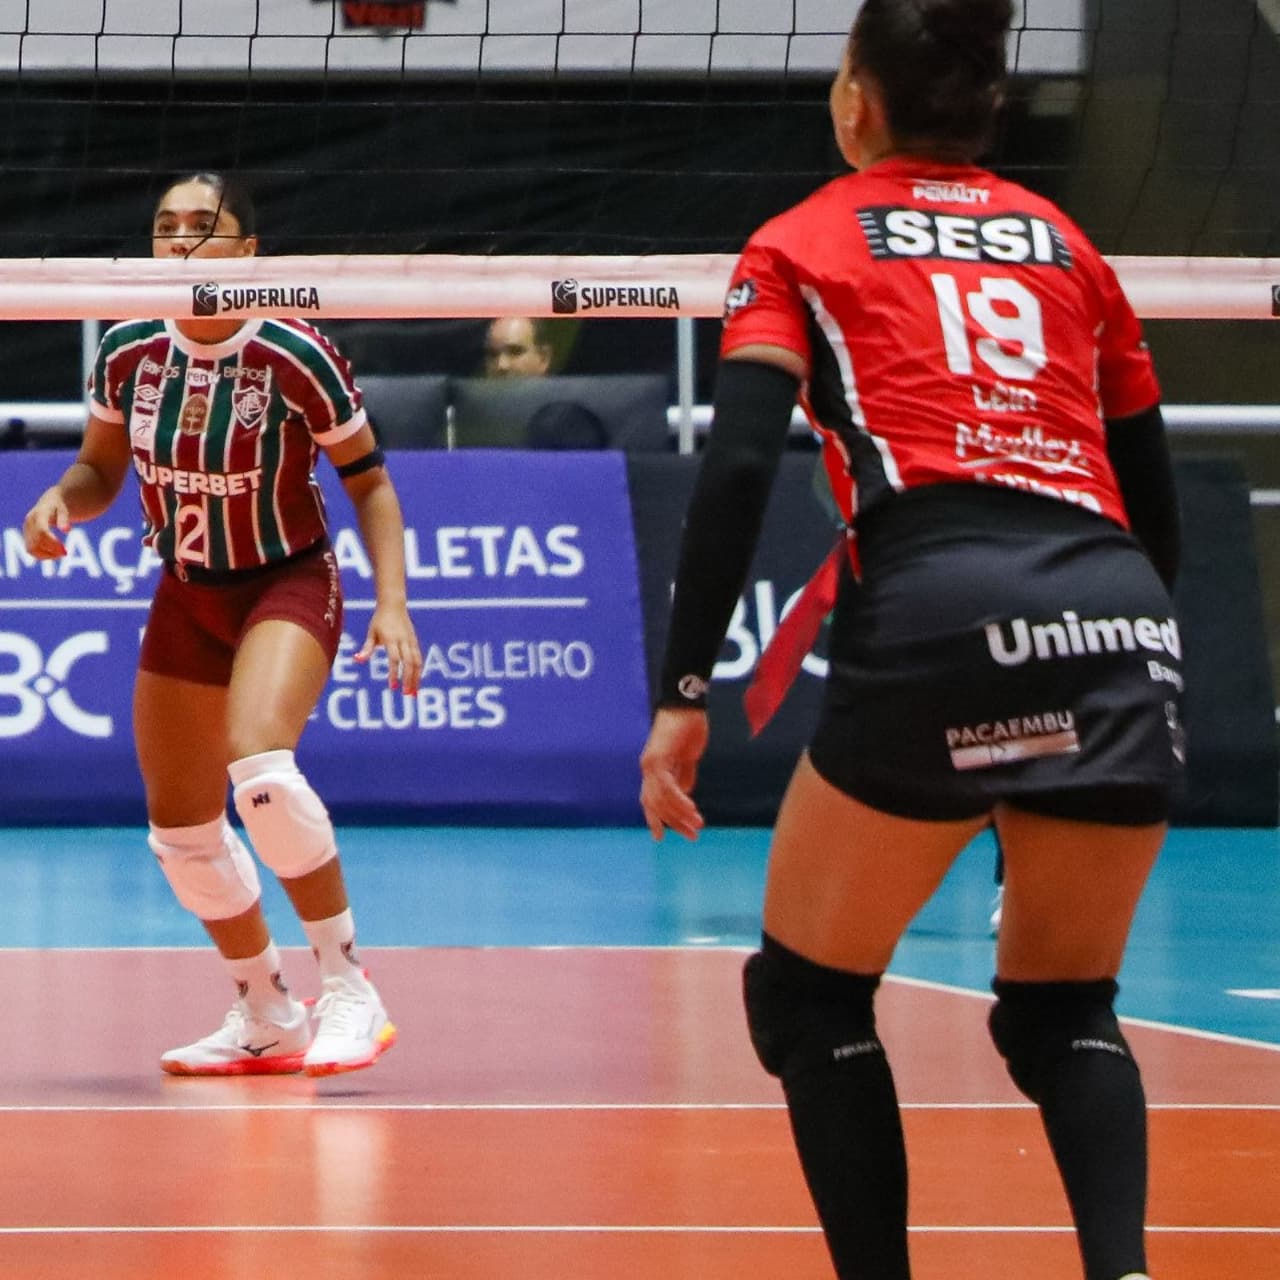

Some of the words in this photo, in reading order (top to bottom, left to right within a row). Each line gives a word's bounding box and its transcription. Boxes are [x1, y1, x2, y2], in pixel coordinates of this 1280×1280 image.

[885, 209, 1054, 263] SESI
[222, 287, 320, 312] SUPERLIGA
[581, 286, 679, 311] SUPERLIGA
[930, 273, 1048, 381] 19
[175, 505, 206, 562] 2
[334, 525, 585, 579] ALETAS
[369, 640, 594, 681] BASILEIRO
[984, 610, 1182, 667] Unimed
[327, 686, 507, 731] CLUBES
[946, 709, 1075, 750] PACAEMBU
